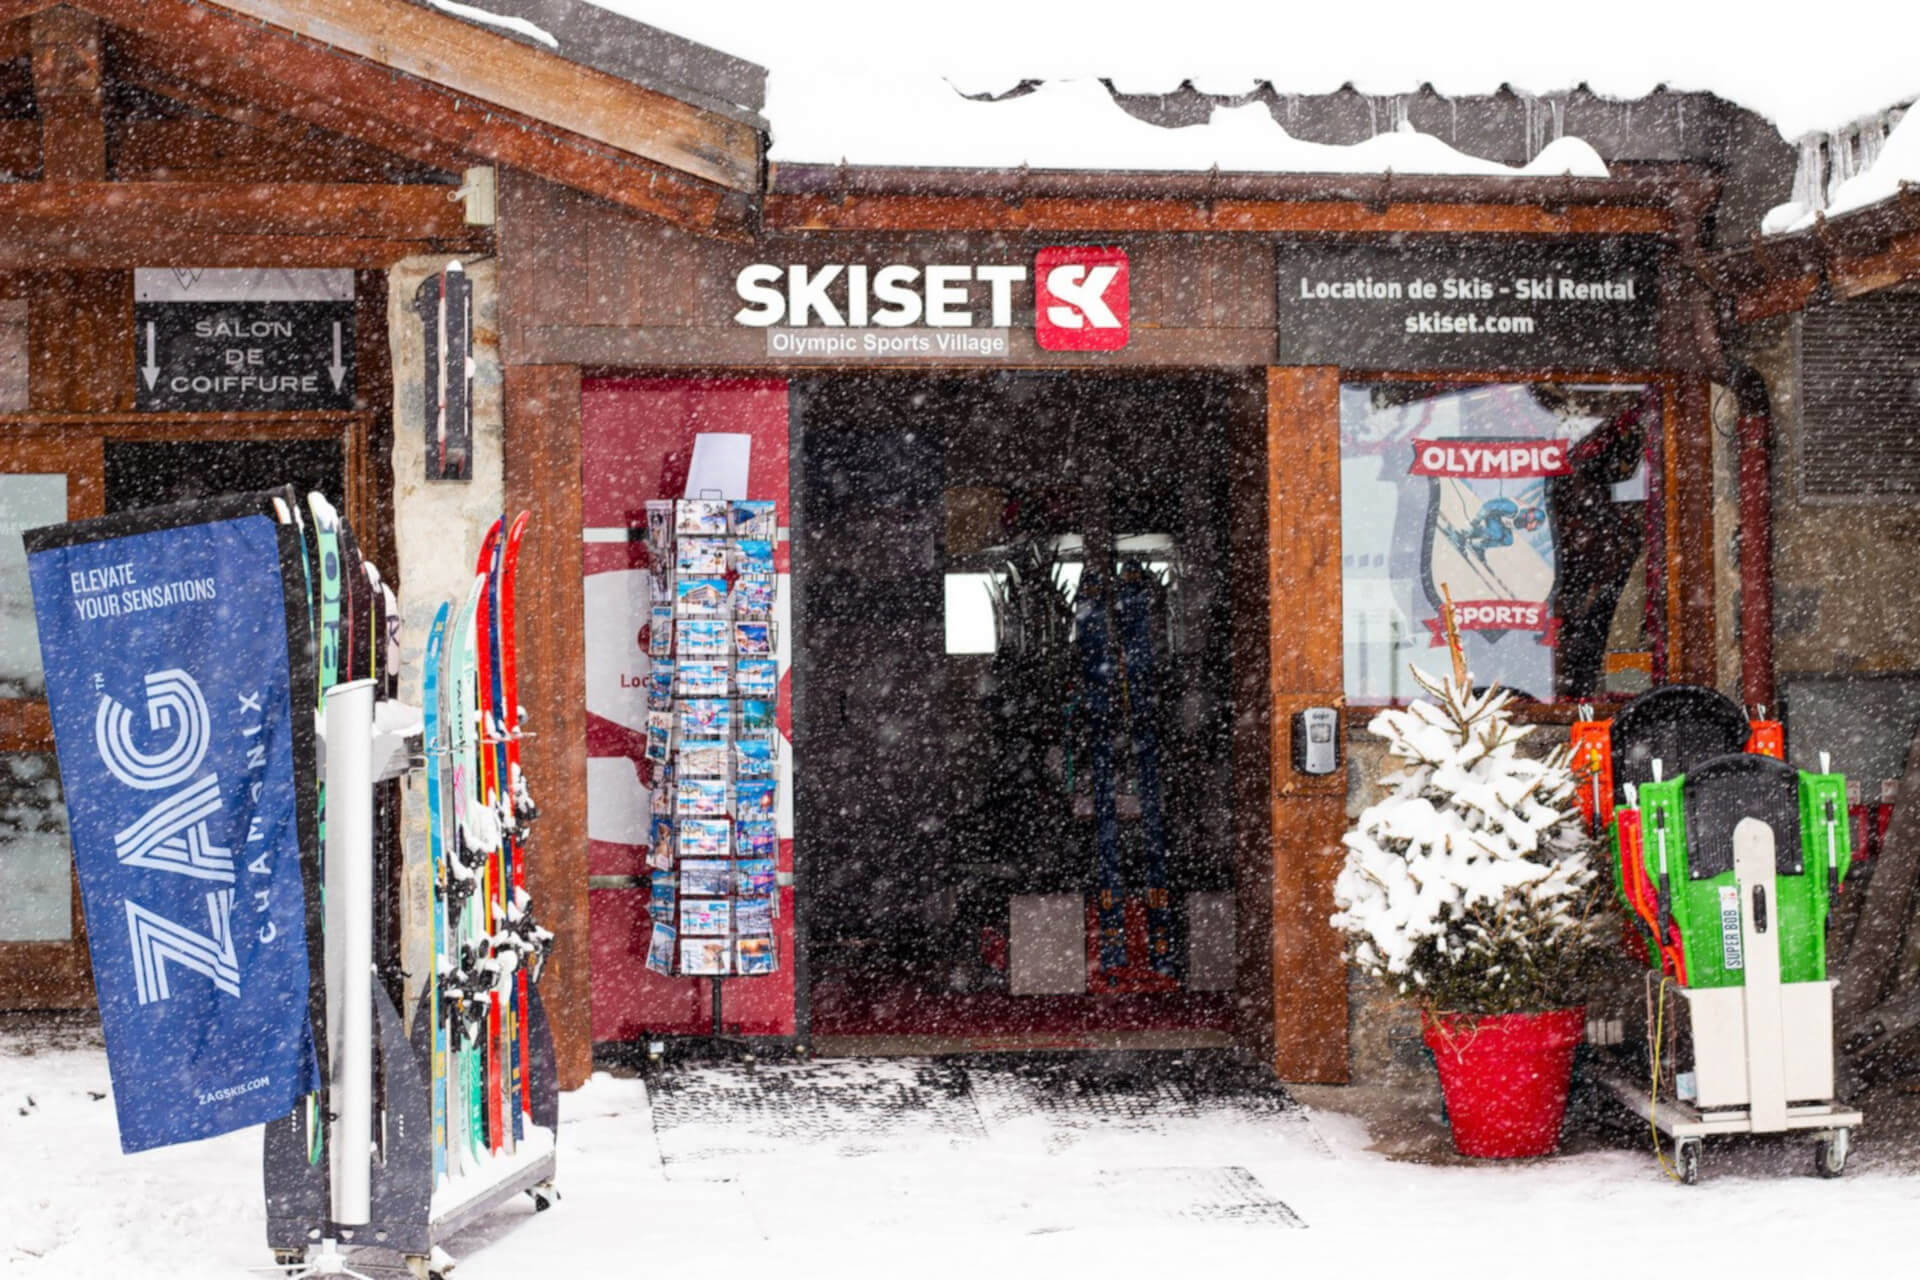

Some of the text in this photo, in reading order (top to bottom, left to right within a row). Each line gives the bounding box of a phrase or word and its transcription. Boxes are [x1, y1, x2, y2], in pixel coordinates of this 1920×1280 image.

[733, 263, 1027, 328] SKISET
[1300, 277, 1402, 300] Location
[1408, 278, 1437, 300] de
[1443, 278, 1493, 300] Skis
[1515, 278, 1553, 300] Ski
[1559, 278, 1637, 300] Rental
[194, 320, 293, 338] SALON
[1404, 311, 1535, 334] skiset.com
[224, 348, 265, 366] DE
[772, 332, 1005, 357] Olympic Sports Village
[170, 375, 319, 393] COIFFURE
[1422, 445, 1562, 473] OLYMPIC
[70, 562, 137, 594] ELEVATE
[75, 577, 217, 621] YOUR SENSATIONS
[1453, 605, 1540, 625] SPORTS
[620, 673, 651, 689] Loc
[237, 690, 277, 944] CHAMONIX
[95, 668, 241, 1005] ZAG
[1723, 909, 1741, 967] SUPER BOB
[198, 1075, 271, 1106] ZAGSKIS.COM
